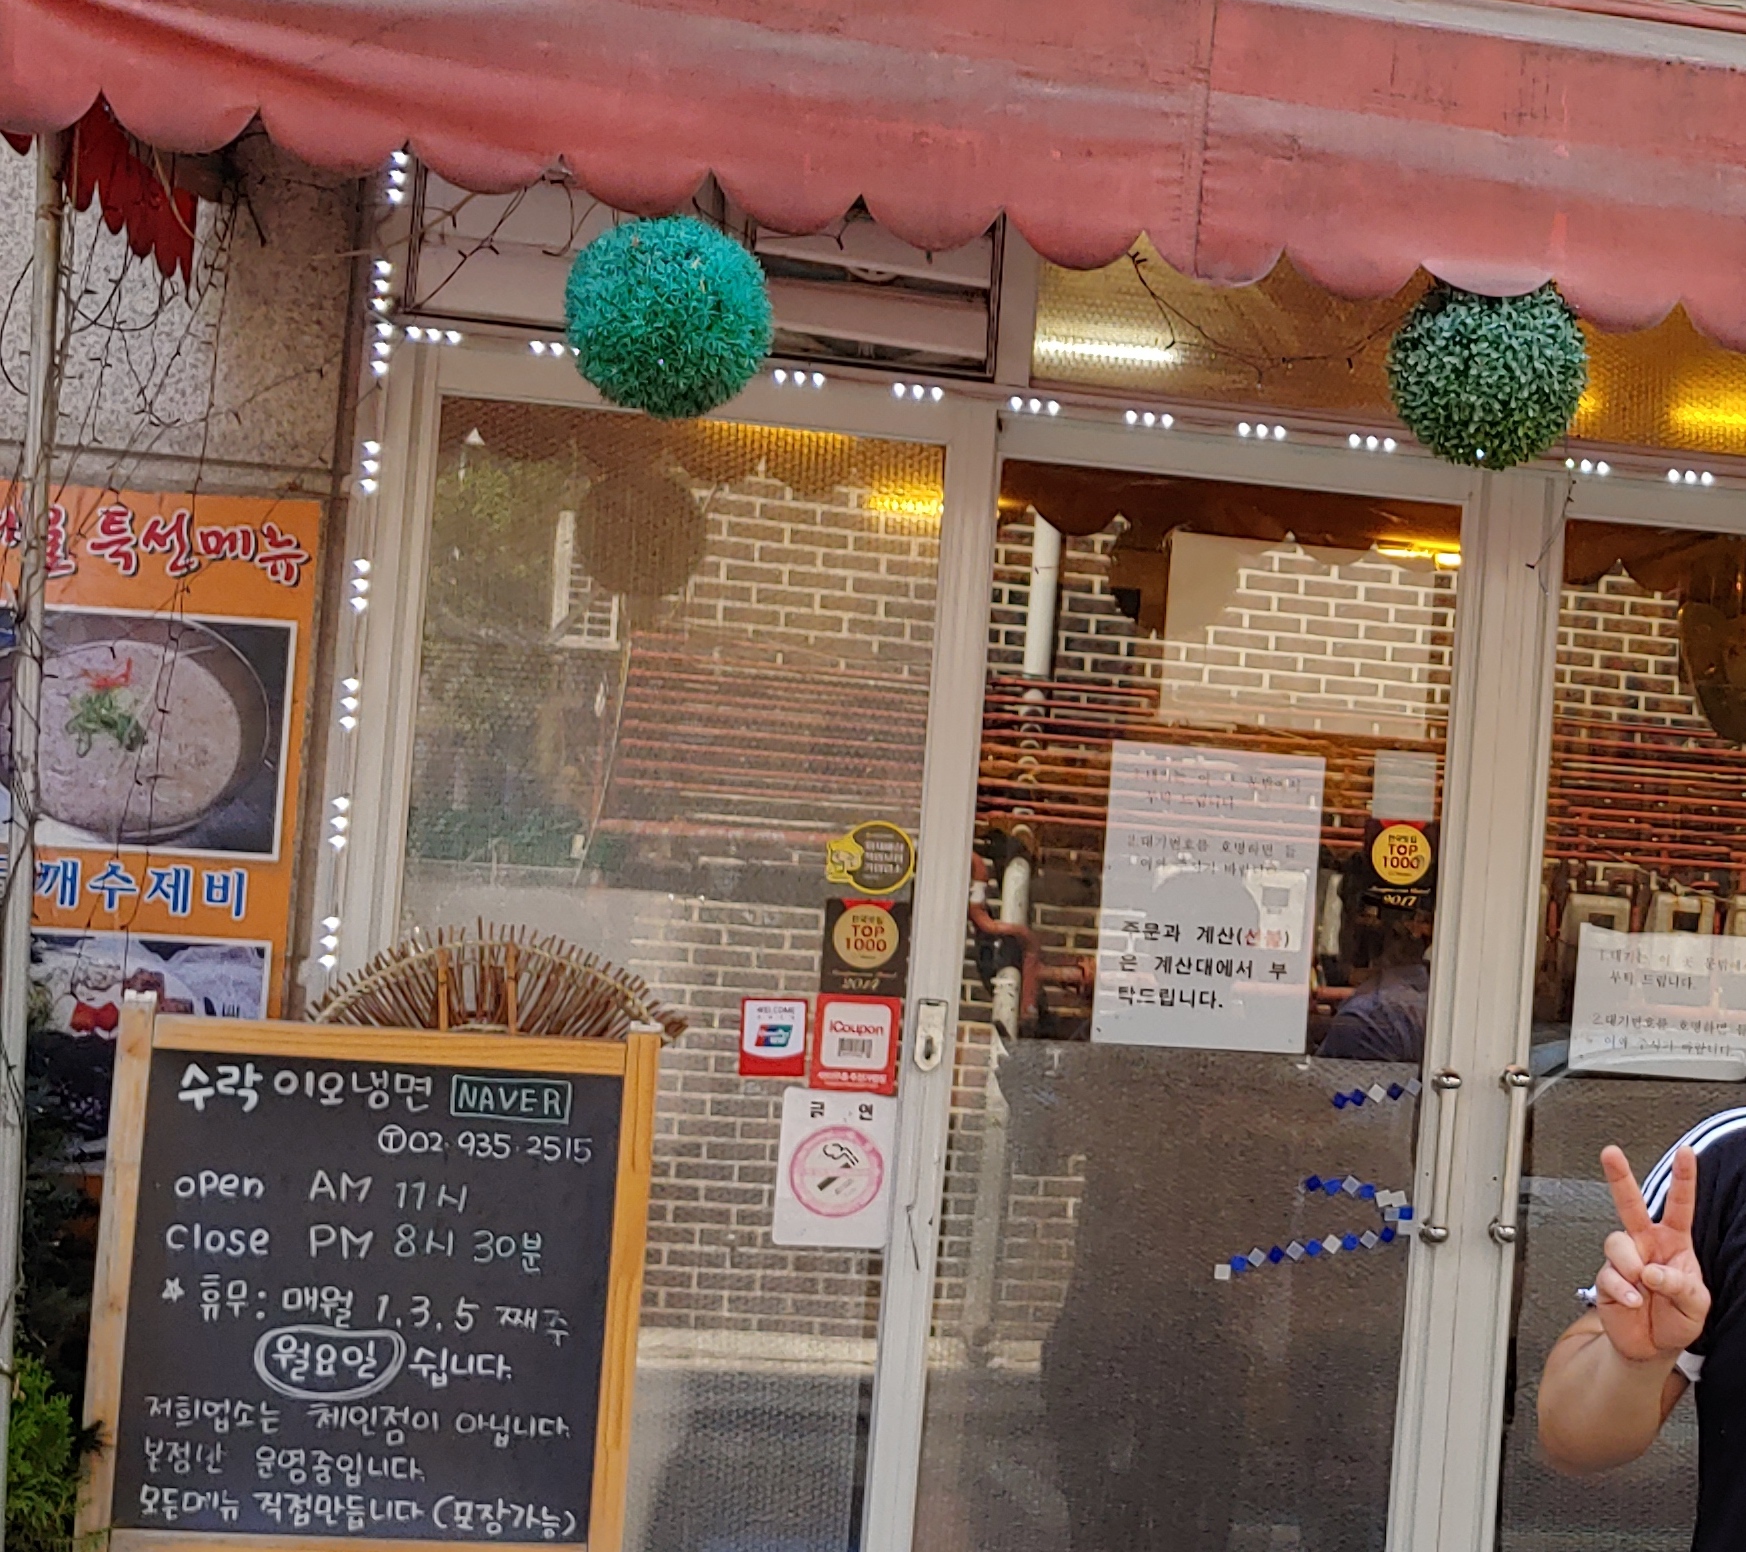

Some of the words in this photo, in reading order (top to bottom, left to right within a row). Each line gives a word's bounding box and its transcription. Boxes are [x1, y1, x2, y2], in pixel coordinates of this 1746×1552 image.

[90, 505, 307, 584] 특선메뉴
[1383, 856, 1420, 869] 1000
[1390, 844, 1418, 856] TOP
[0, 852, 247, 918] 깨수제비
[845, 937, 887, 953] 1000
[851, 924, 886, 938] TOP
[1121, 920, 1181, 943] 주문과
[1119, 954, 1138, 973] 은
[1154, 955, 1254, 979] 계산대에서
[1269, 961, 1288, 980] 부
[1118, 985, 1224, 1010] 탁드립니다.
[456, 1081, 563, 1117] NAVER
[309, 1168, 374, 1204] AM
[309, 1223, 374, 1261] PM
[282, 1284, 354, 1330] 매월
[272, 1333, 379, 1382] 월요일
